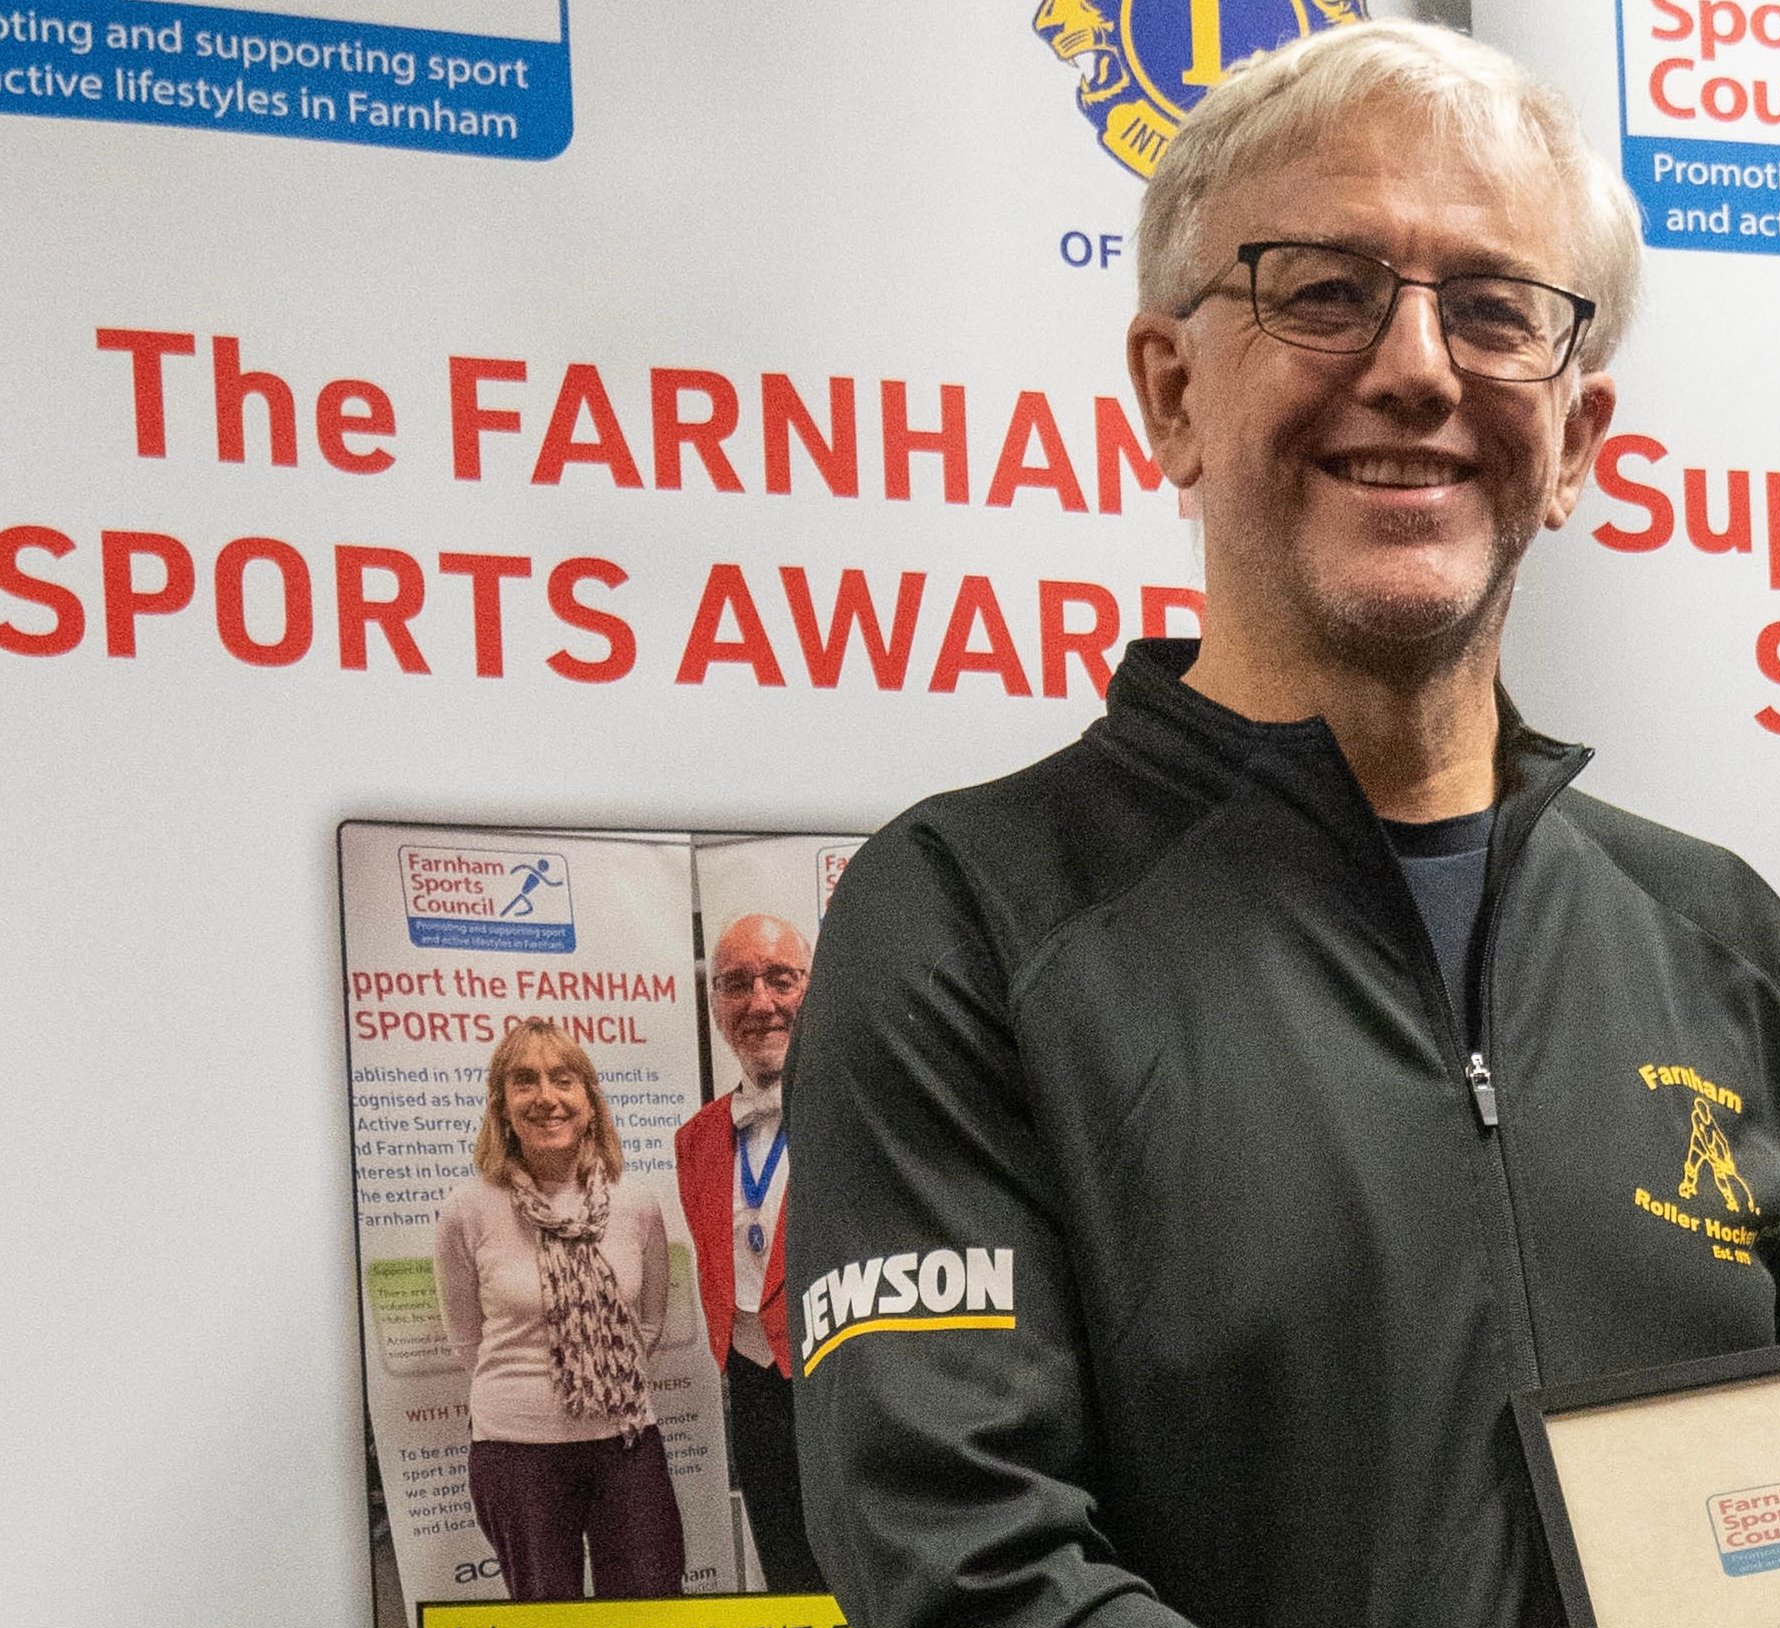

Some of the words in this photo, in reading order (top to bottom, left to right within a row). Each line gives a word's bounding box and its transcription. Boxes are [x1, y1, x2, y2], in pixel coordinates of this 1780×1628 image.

[106, 20, 182, 53] and
[196, 34, 416, 82] supporting
[429, 52, 529, 90] sport
[115, 69, 288, 117] lifestyles
[301, 87, 336, 121] in
[349, 92, 518, 140] Farnham
[1667, 201, 1732, 237] and
[1060, 231, 1123, 269] OF
[96, 328, 396, 475] The
[0, 524, 637, 684] SPORTS
[408, 854, 504, 876] Farnham
[411, 875, 484, 895] Sports
[412, 895, 494, 916] Council
[454, 968, 507, 999] the
[516, 970, 676, 1003] FARNHAM
[355, 1010, 494, 1043] SPORTS
[504, 1014, 646, 1044] CNCIL
[434, 1070, 448, 1082] in
[1638, 1064, 1743, 1114] Farnham
[358, 1117, 409, 1132] Active
[414, 1117, 477, 1134] Surrey,
[629, 1114, 682, 1128] Council
[376, 1141, 454, 1155] Farnham
[416, 1167, 431, 1178] in
[436, 1164, 475, 1178] local
[385, 1189, 445, 1203] extract
[1634, 1188, 1700, 1231] Roller
[801, 1247, 1013, 1361] JEWSON
[406, 1406, 449, 1422] WITH
[403, 1466, 443, 1482] sport
[408, 1501, 472, 1519] working
[413, 1523, 440, 1537] and
